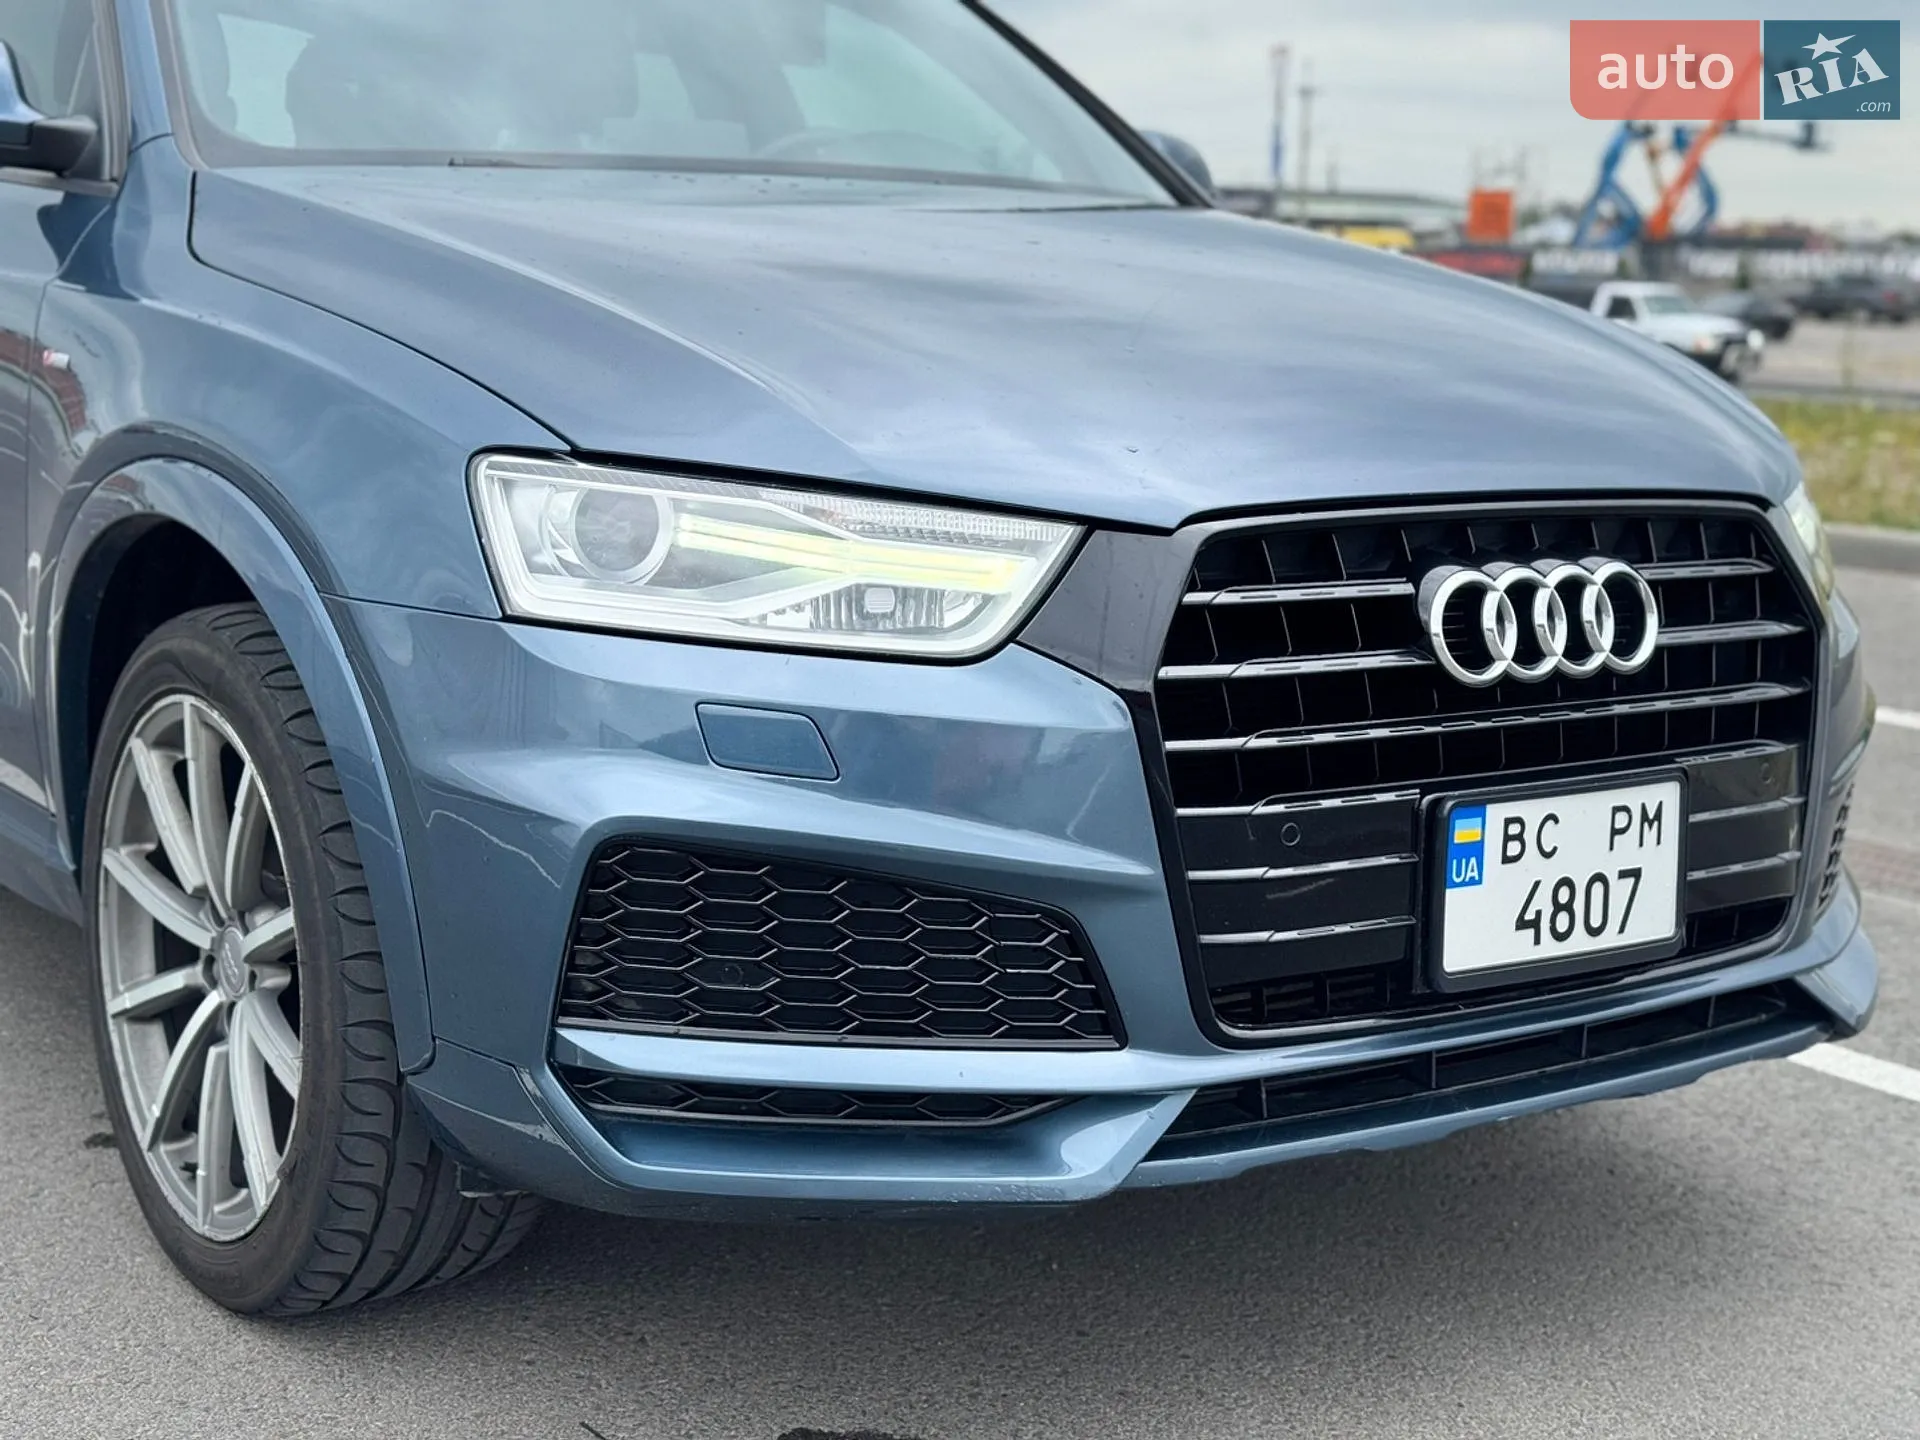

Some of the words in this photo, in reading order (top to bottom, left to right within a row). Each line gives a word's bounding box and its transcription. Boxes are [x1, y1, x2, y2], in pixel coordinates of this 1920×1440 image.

[1501, 812, 1560, 865] BC
[1609, 800, 1663, 851] PM
[1452, 856, 1479, 883] UA
[1515, 866, 1642, 946] 4807
